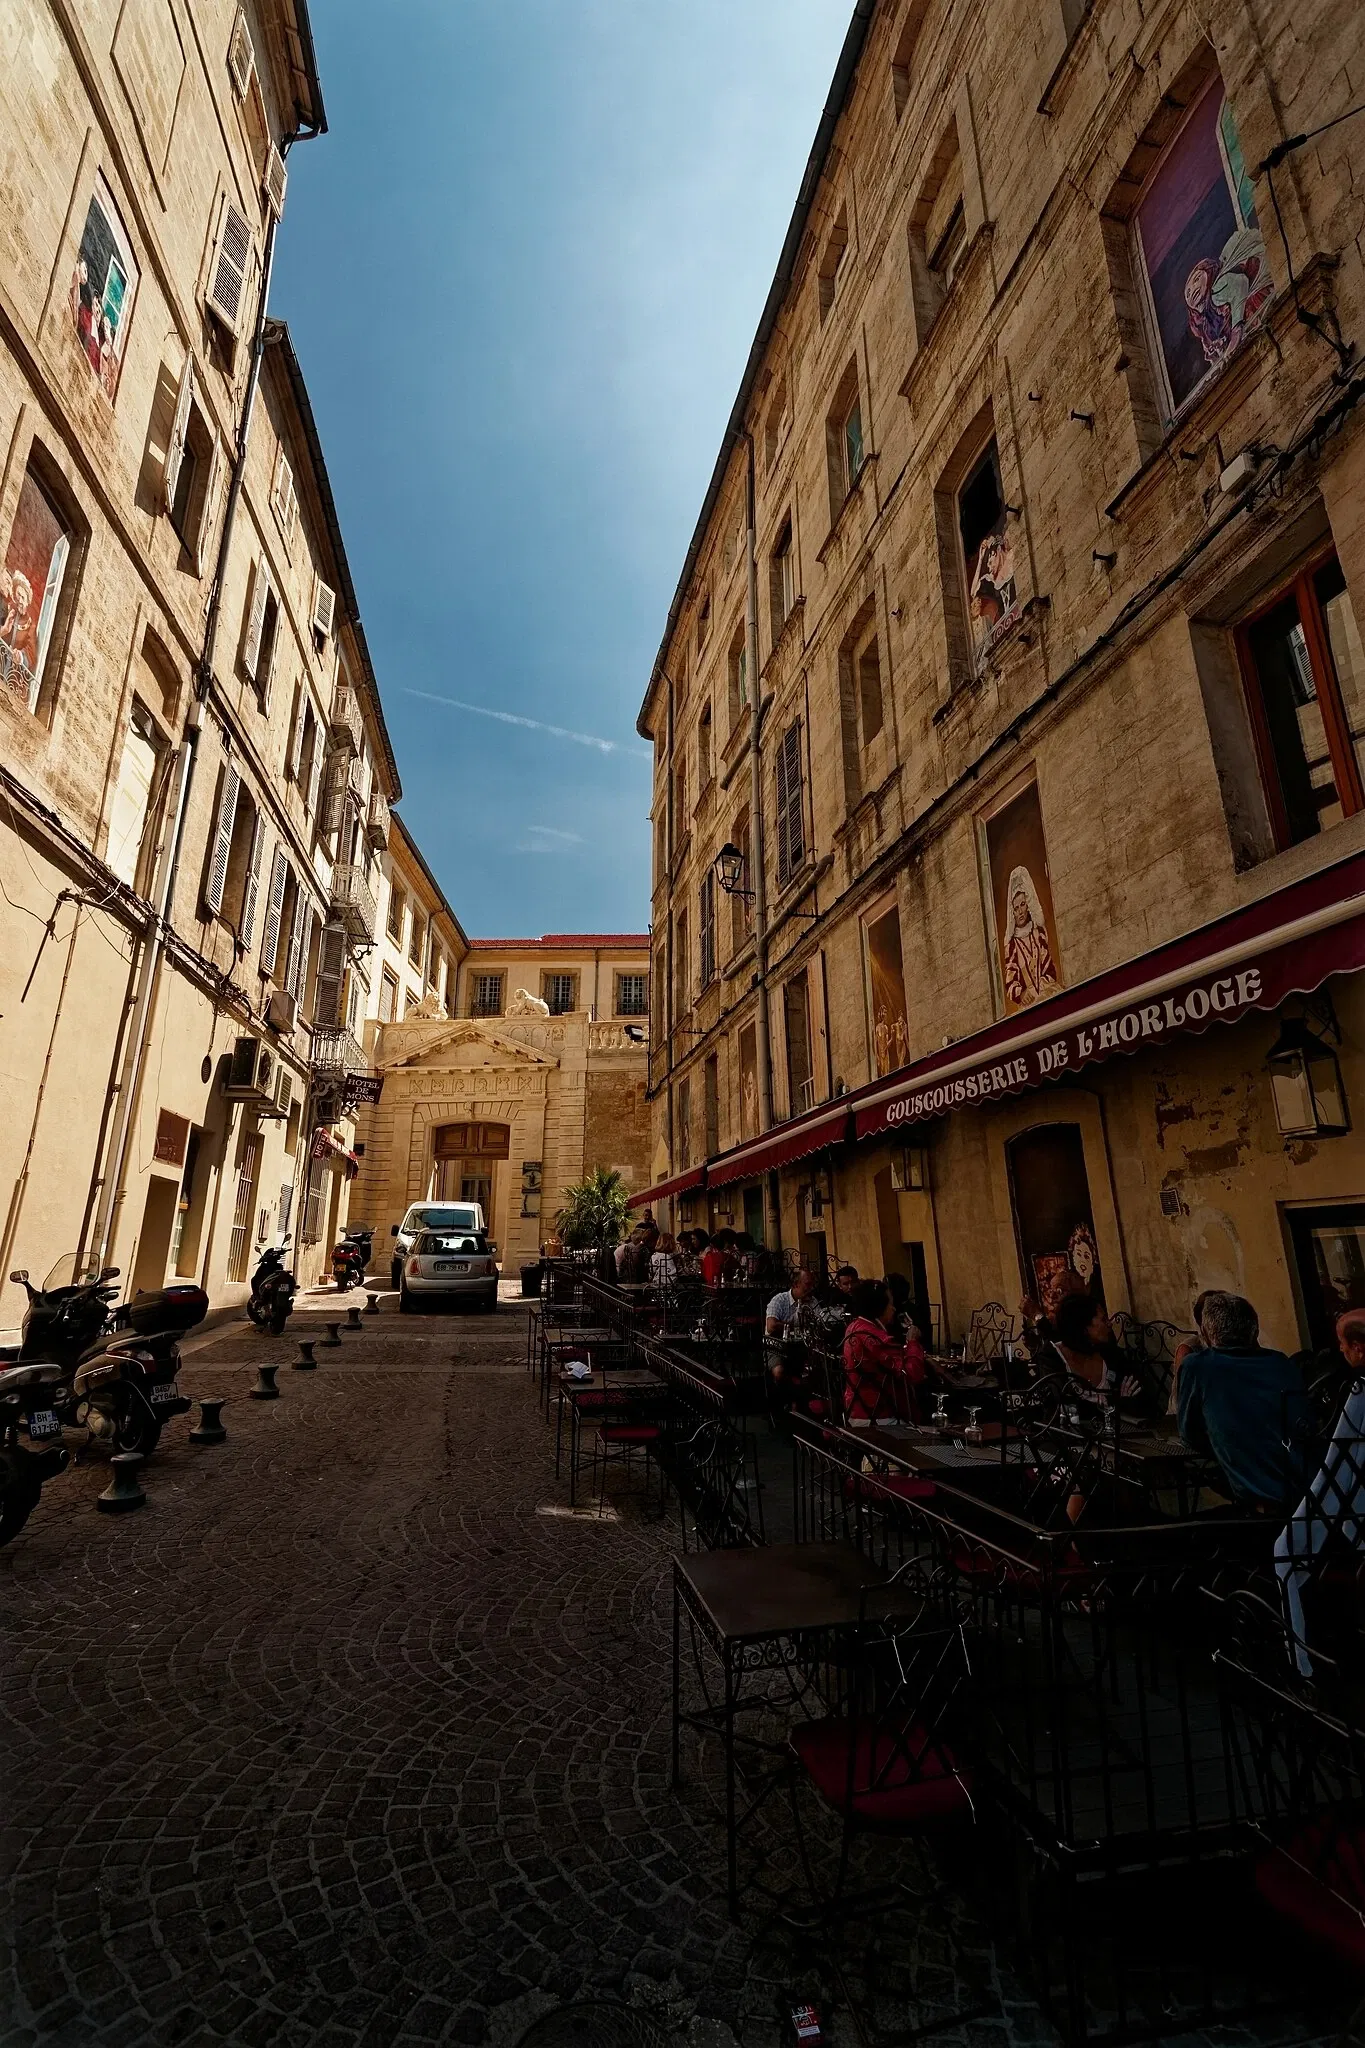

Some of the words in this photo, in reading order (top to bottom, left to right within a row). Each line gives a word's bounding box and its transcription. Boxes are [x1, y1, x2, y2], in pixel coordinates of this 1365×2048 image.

[886, 1059, 1029, 1122] COUSCOUSSERIE
[1036, 1040, 1069, 1074] DE
[1077, 968, 1263, 1058] L'HORLOGE
[347, 1078, 380, 1089] HOTEL
[355, 1086, 369, 1095] DE
[346, 1092, 375, 1102] MONS
